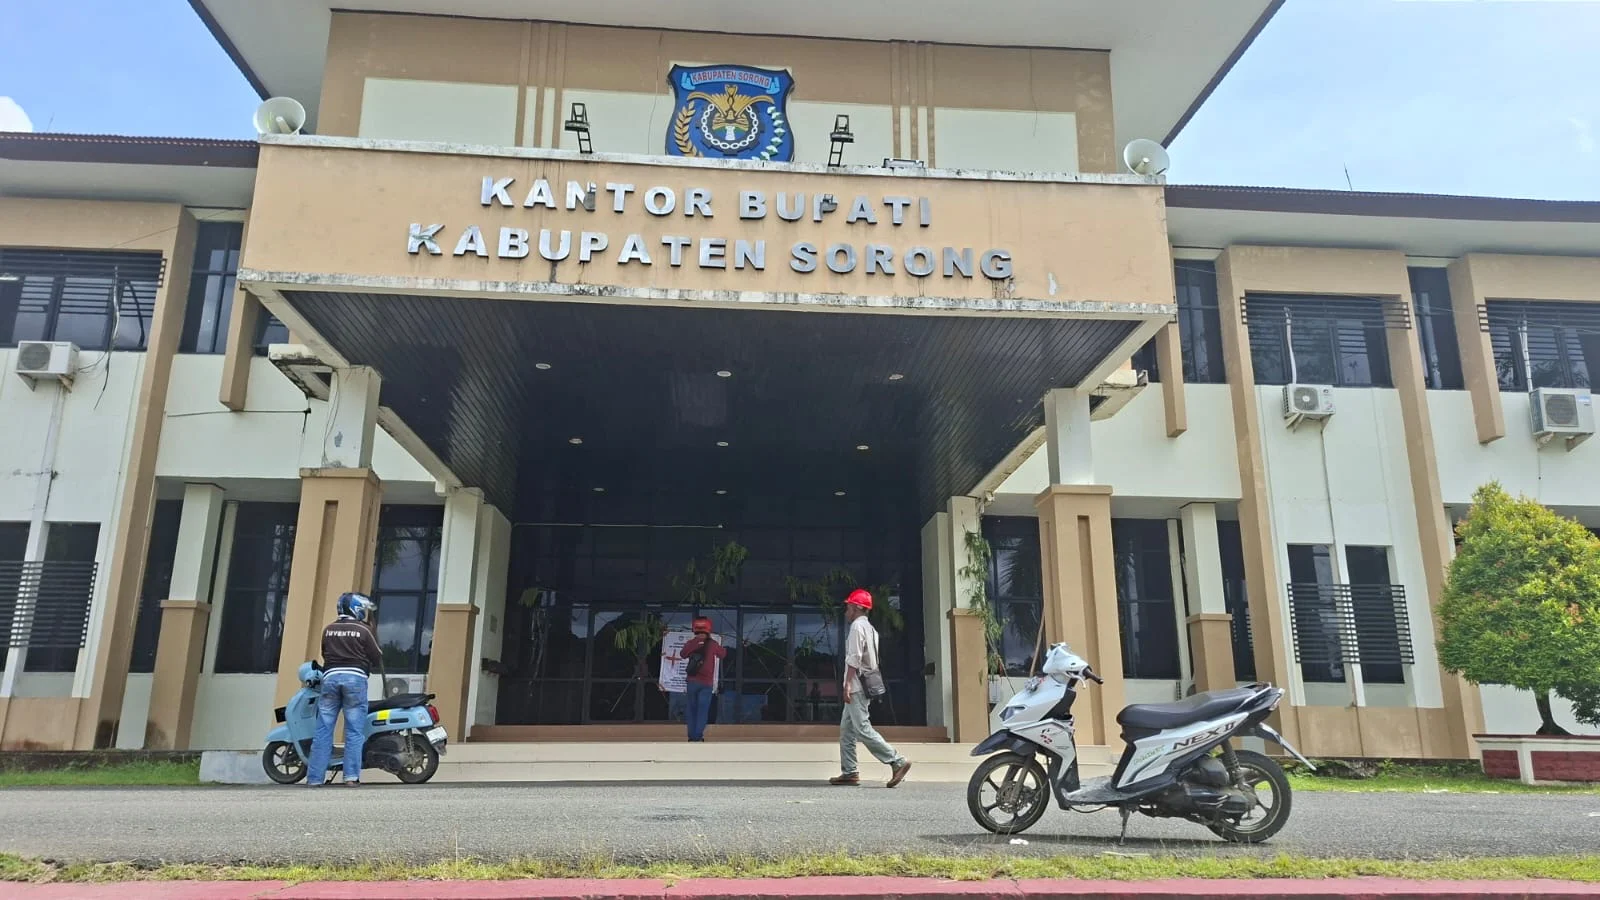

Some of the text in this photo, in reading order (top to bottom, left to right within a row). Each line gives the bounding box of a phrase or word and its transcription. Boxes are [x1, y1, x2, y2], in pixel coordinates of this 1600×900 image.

[692, 71, 769, 87] KABUPATEN SORONG
[480, 175, 931, 227] KANTOR BUPATI
[407, 223, 1012, 279] KABUPATEN SORONG
[325, 629, 361, 638] JUVENTUS
[1172, 727, 1220, 750] NEX
